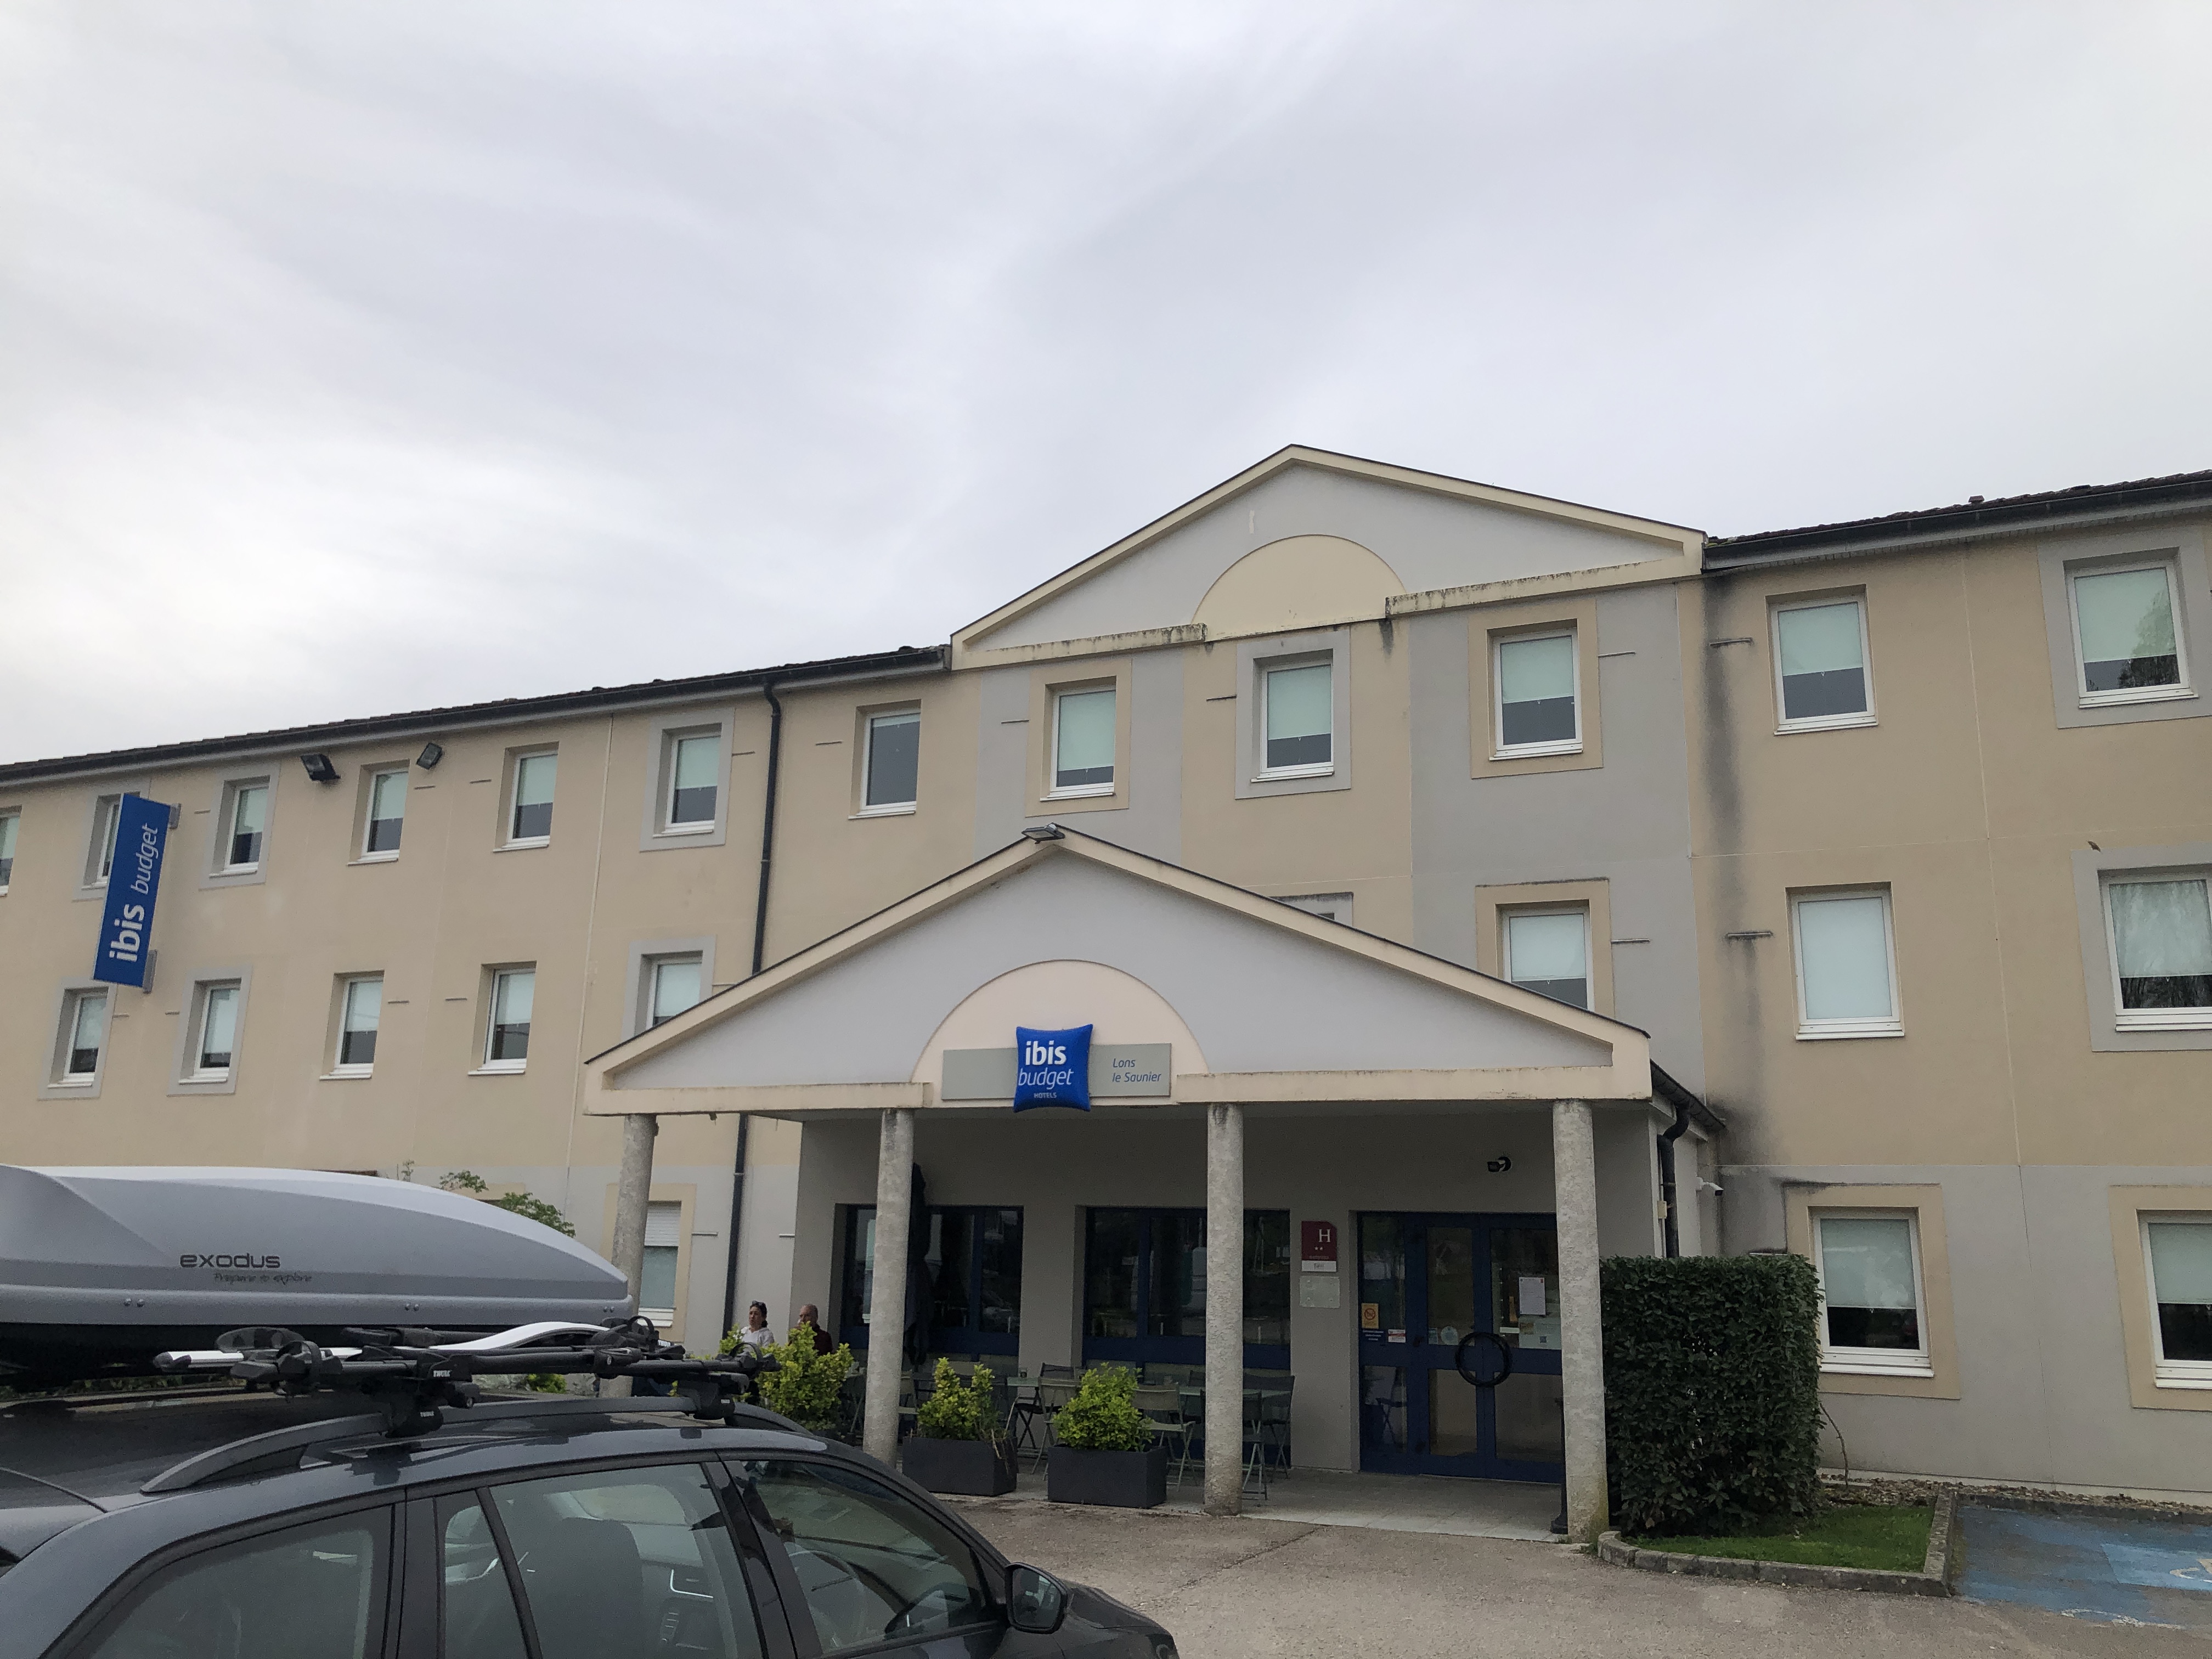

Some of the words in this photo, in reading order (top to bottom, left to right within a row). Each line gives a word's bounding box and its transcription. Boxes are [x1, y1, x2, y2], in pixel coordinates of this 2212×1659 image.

[109, 904, 144, 962] ibis
[131, 823, 158, 895] budget
[1025, 1040, 1066, 1065] ibis
[1113, 1058, 1136, 1068] Lons
[1018, 1067, 1074, 1090] budget
[1112, 1072, 1121, 1082] le
[1124, 1071, 1162, 1082] Saunier
[1318, 1228, 1331, 1243] H
[180, 1252, 281, 1268] exodus
